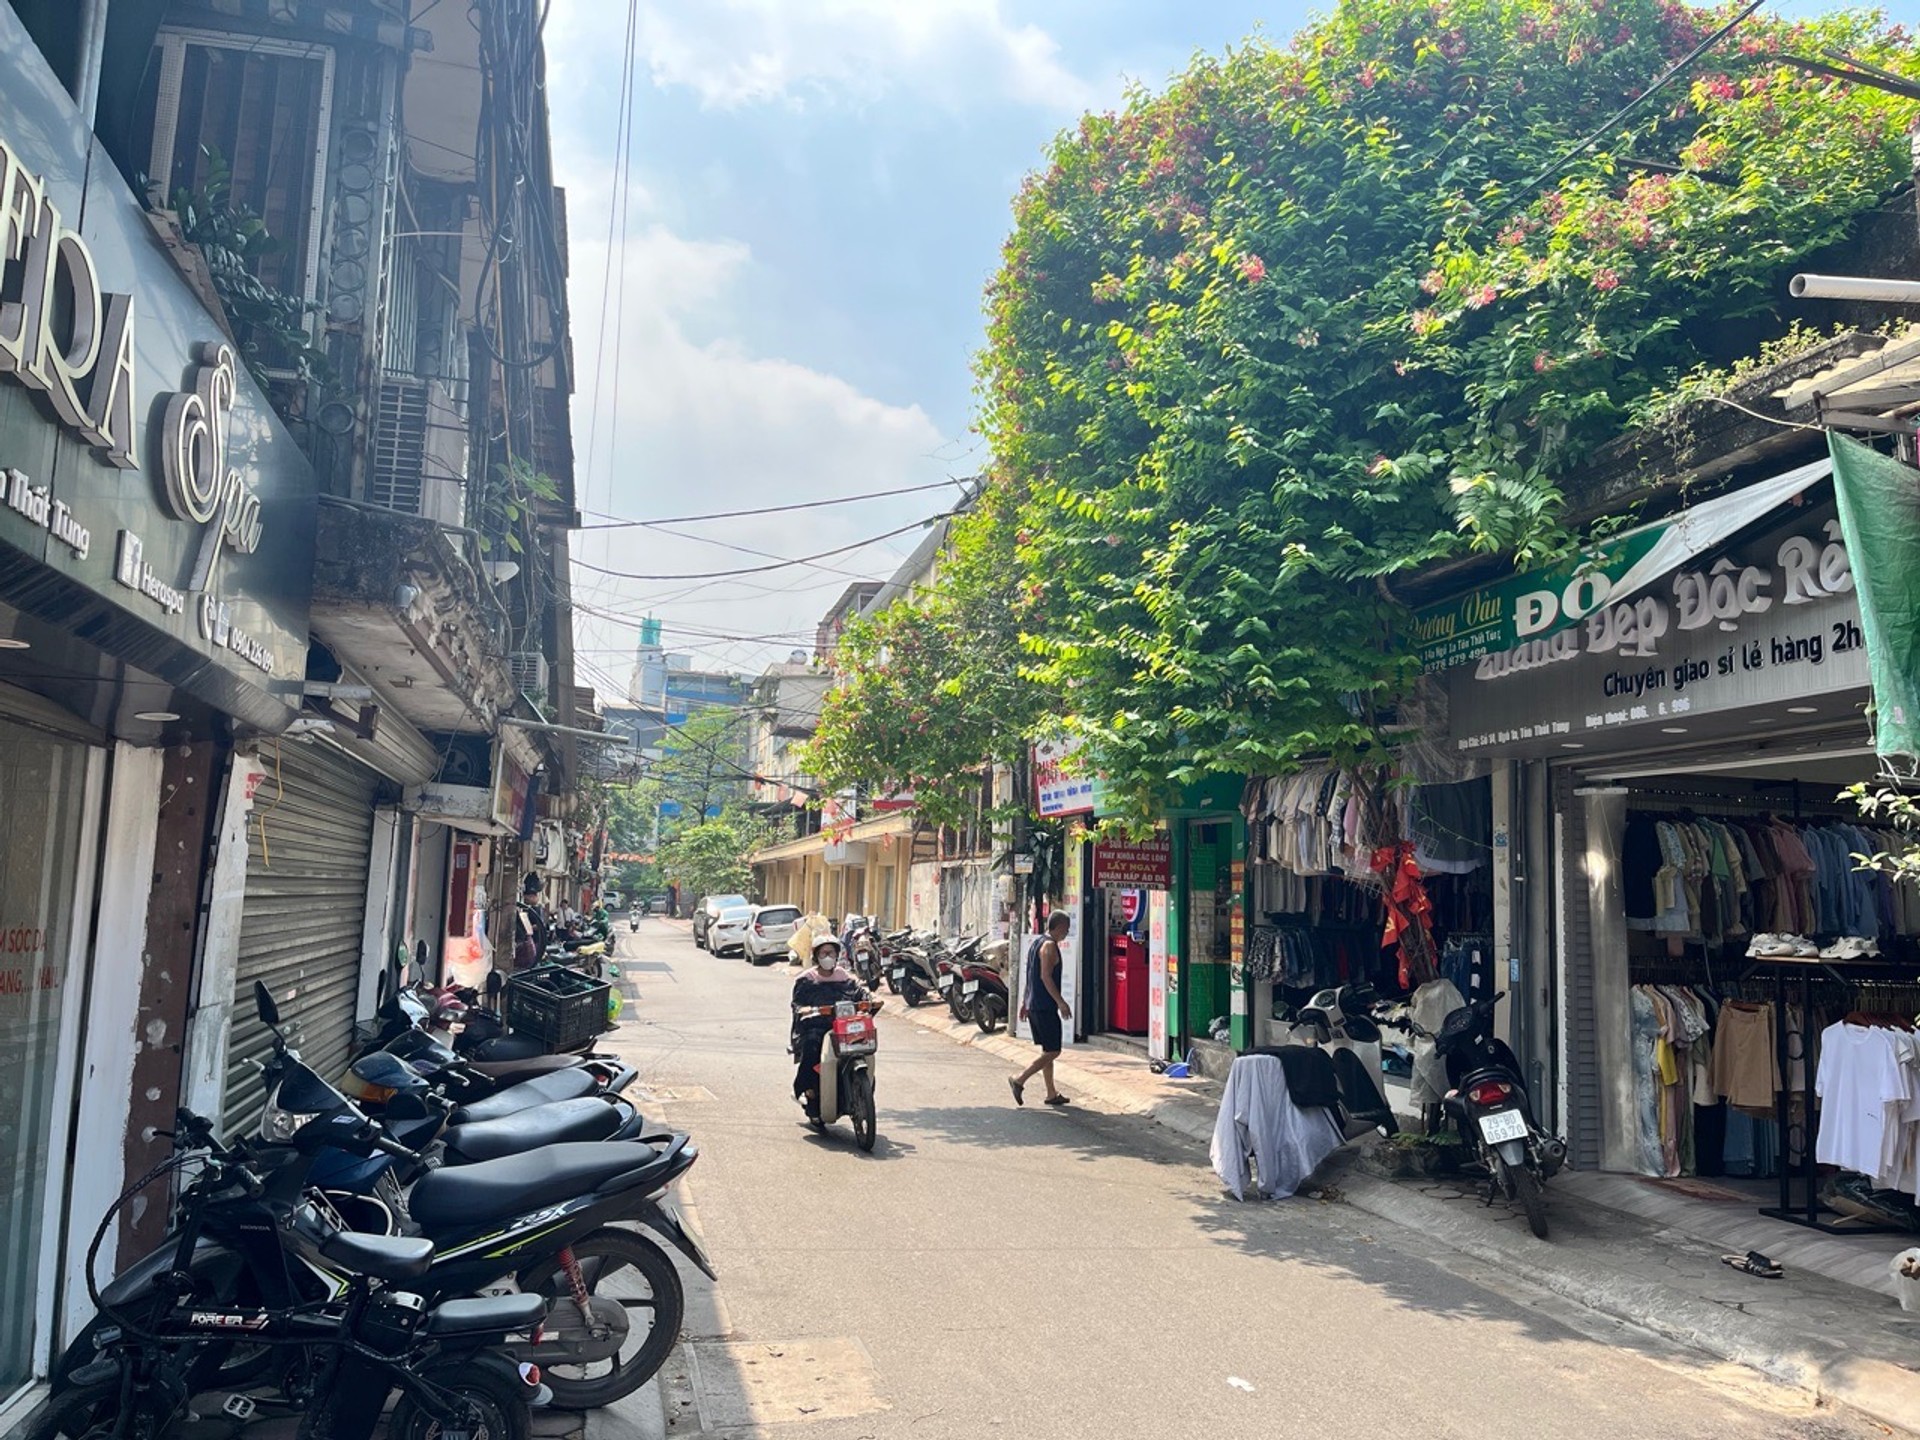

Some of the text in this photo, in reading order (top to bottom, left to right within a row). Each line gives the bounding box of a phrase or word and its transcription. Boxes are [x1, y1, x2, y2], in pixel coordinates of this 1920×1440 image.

[165, 344, 263, 592] Spa
[8, 468, 51, 528] Thất
[51, 499, 90, 560] Tùng
[1673, 559, 1772, 632] Độc
[1778, 519, 1853, 604] Rẻ
[1603, 667, 1667, 698] Chuyên
[1673, 658, 1711, 692] giao
[1771, 634, 1824, 664] hàng
[1831, 620, 1865, 651] 2h
[1107, 860, 1158, 872] LẤY NGAY
[8, 922, 31, 953] SÓC
